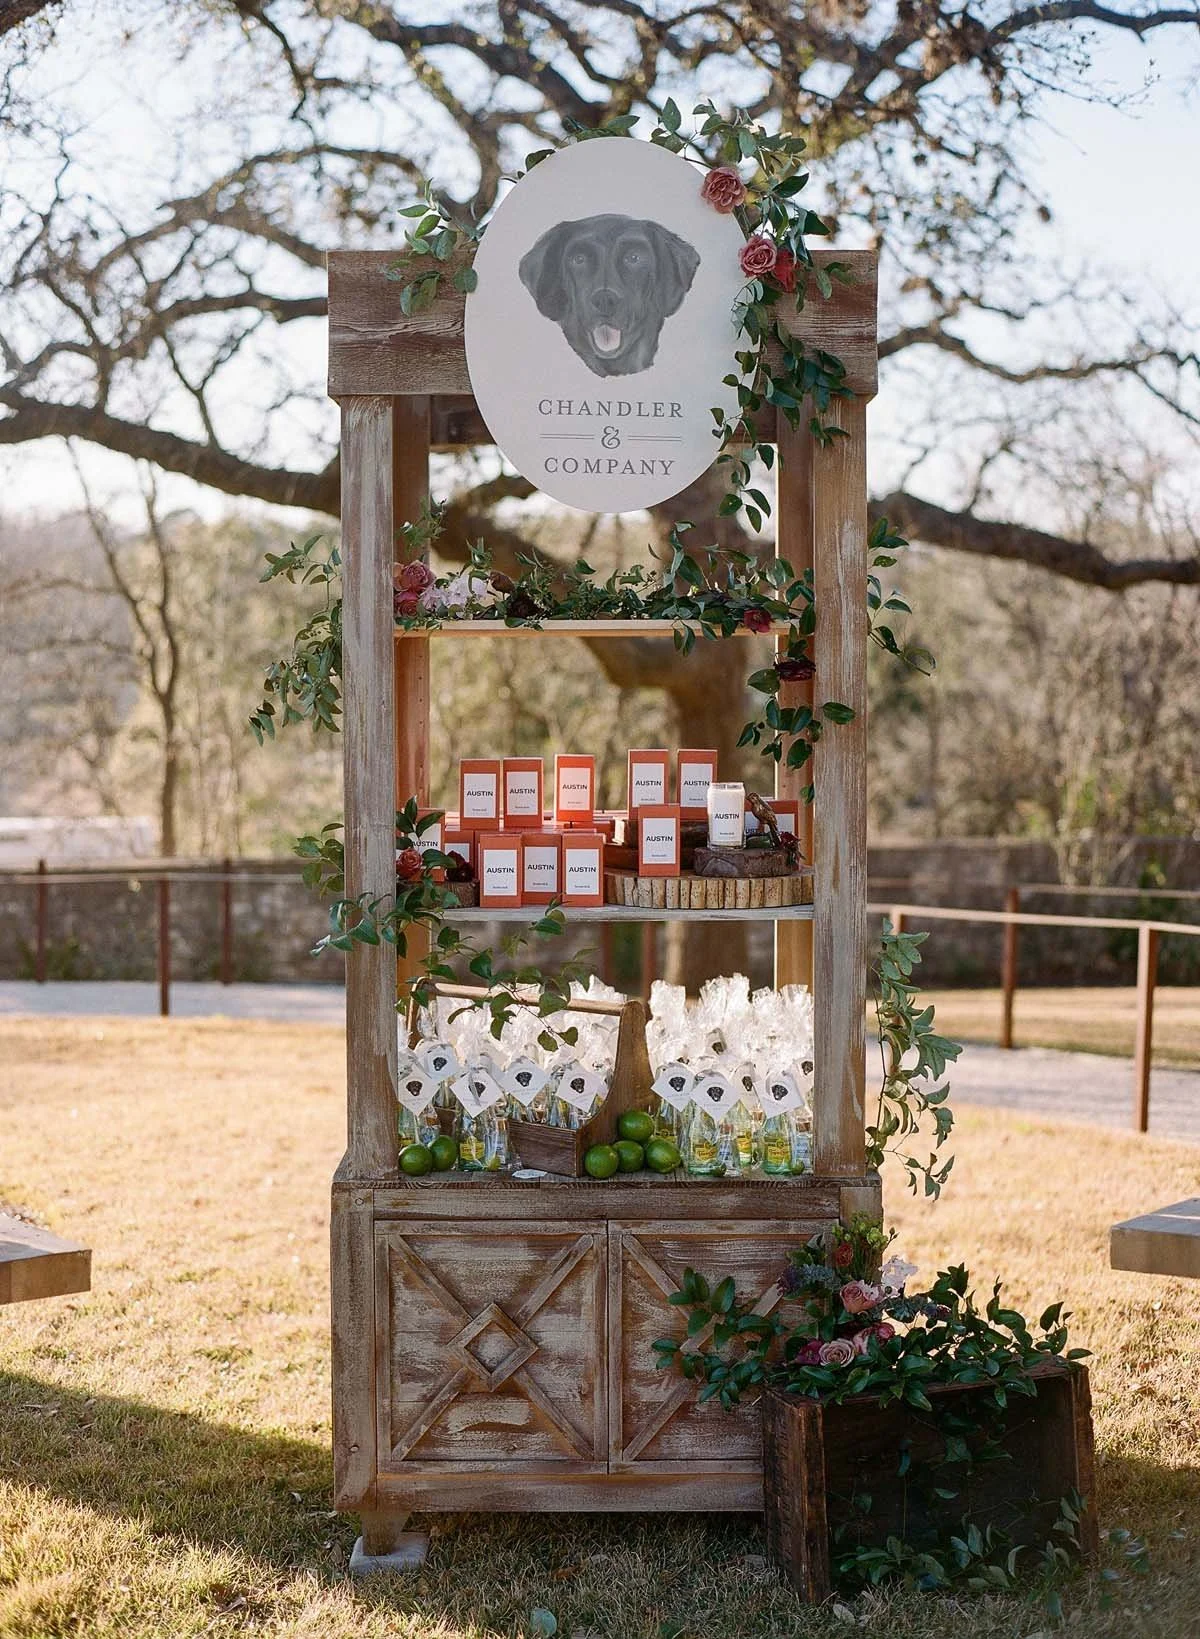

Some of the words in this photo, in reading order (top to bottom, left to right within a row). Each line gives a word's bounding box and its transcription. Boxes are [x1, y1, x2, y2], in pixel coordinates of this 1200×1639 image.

[538, 399, 684, 418] CHANDLER
[601, 425, 621, 449] &
[544, 457, 675, 476] COMPANY
